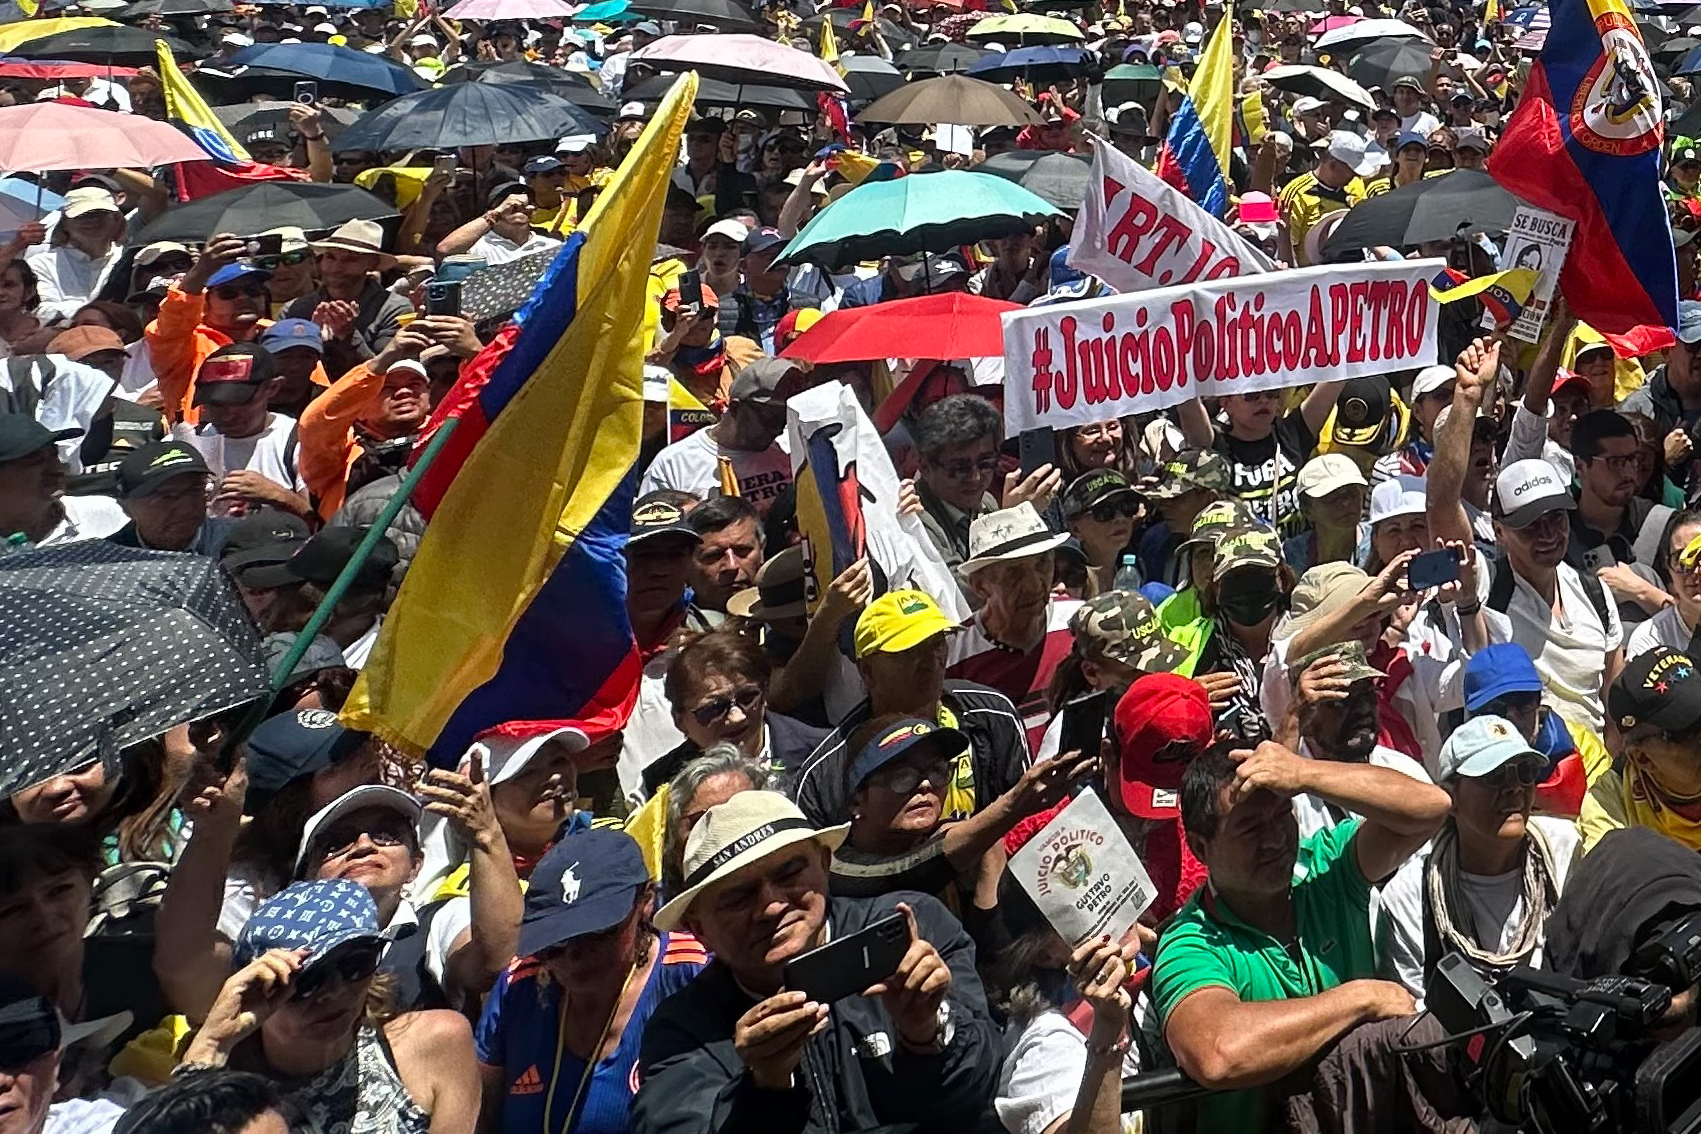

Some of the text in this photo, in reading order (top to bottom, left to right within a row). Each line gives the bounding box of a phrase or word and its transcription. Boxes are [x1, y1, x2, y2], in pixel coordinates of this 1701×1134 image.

[1581, 133, 1622, 154] ORDEN
[1514, 213, 1529, 230] SE
[1529, 218, 1568, 240] BUSCA
[739, 469, 788, 490] ERA
[747, 481, 789, 503] TRO
[1513, 474, 1553, 497] adidas
[712, 824, 776, 868] SAN ANDRES
[1037, 829, 1104, 897] JUICIO POLITICO
[1075, 872, 1111, 911] GUSTAVO
[1087, 884, 1112, 912] PETRO
